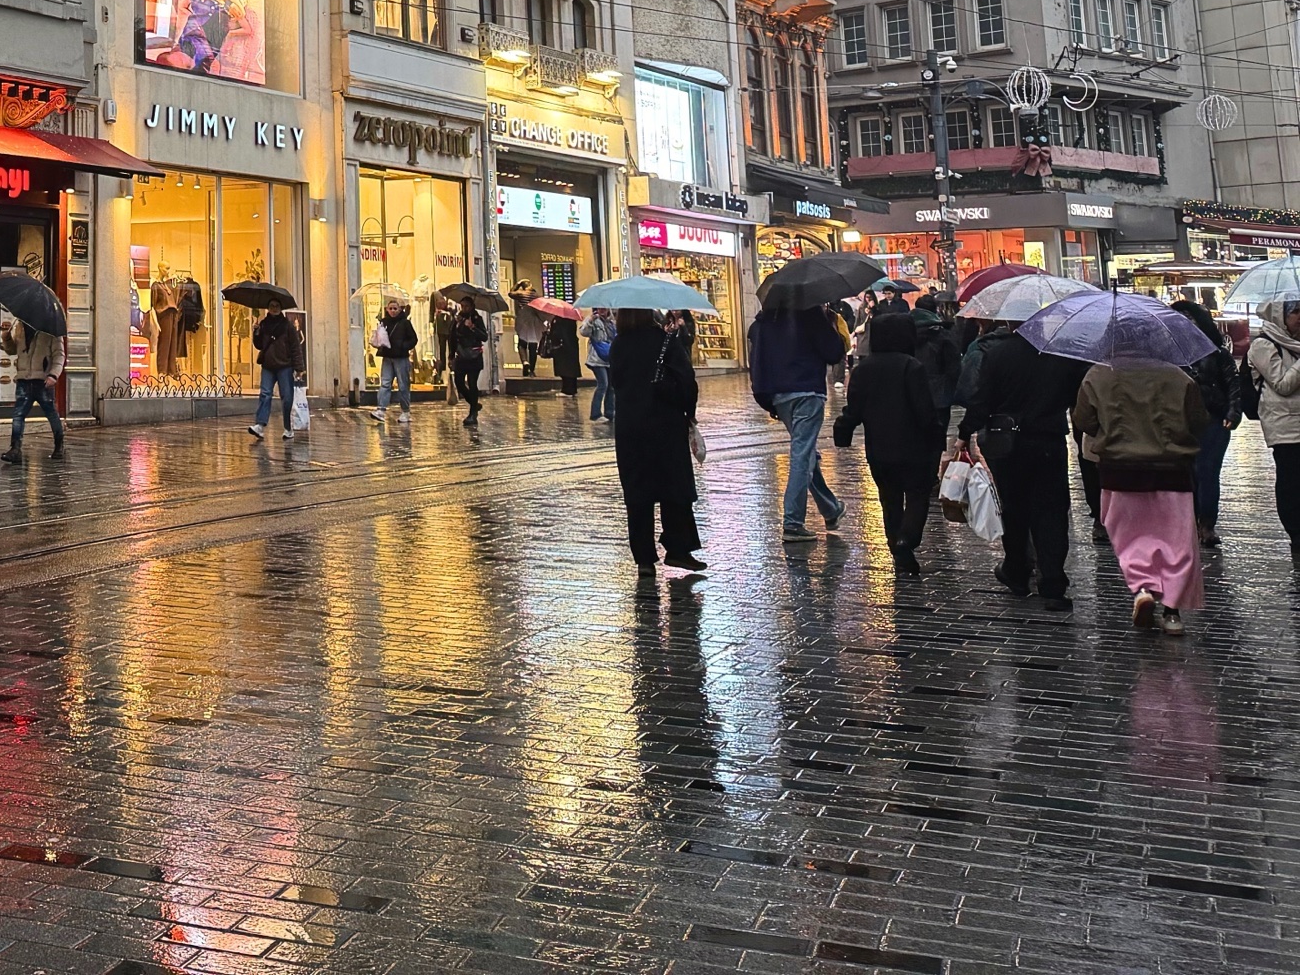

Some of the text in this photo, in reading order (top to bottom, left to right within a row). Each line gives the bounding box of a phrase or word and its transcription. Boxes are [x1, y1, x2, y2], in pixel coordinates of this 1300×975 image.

[145, 104, 305, 151] JIMMY KEY
[509, 117, 563, 145] CHANGE
[567, 129, 610, 156] OFFICE
[353, 111, 476, 166] zeropoint
[796, 200, 832, 219] patsosis
[915, 207, 989, 223] SWAVSKI
[1070, 203, 1114, 219] SWAROVSKI
[1251, 236, 1300, 248] PERAMONA
